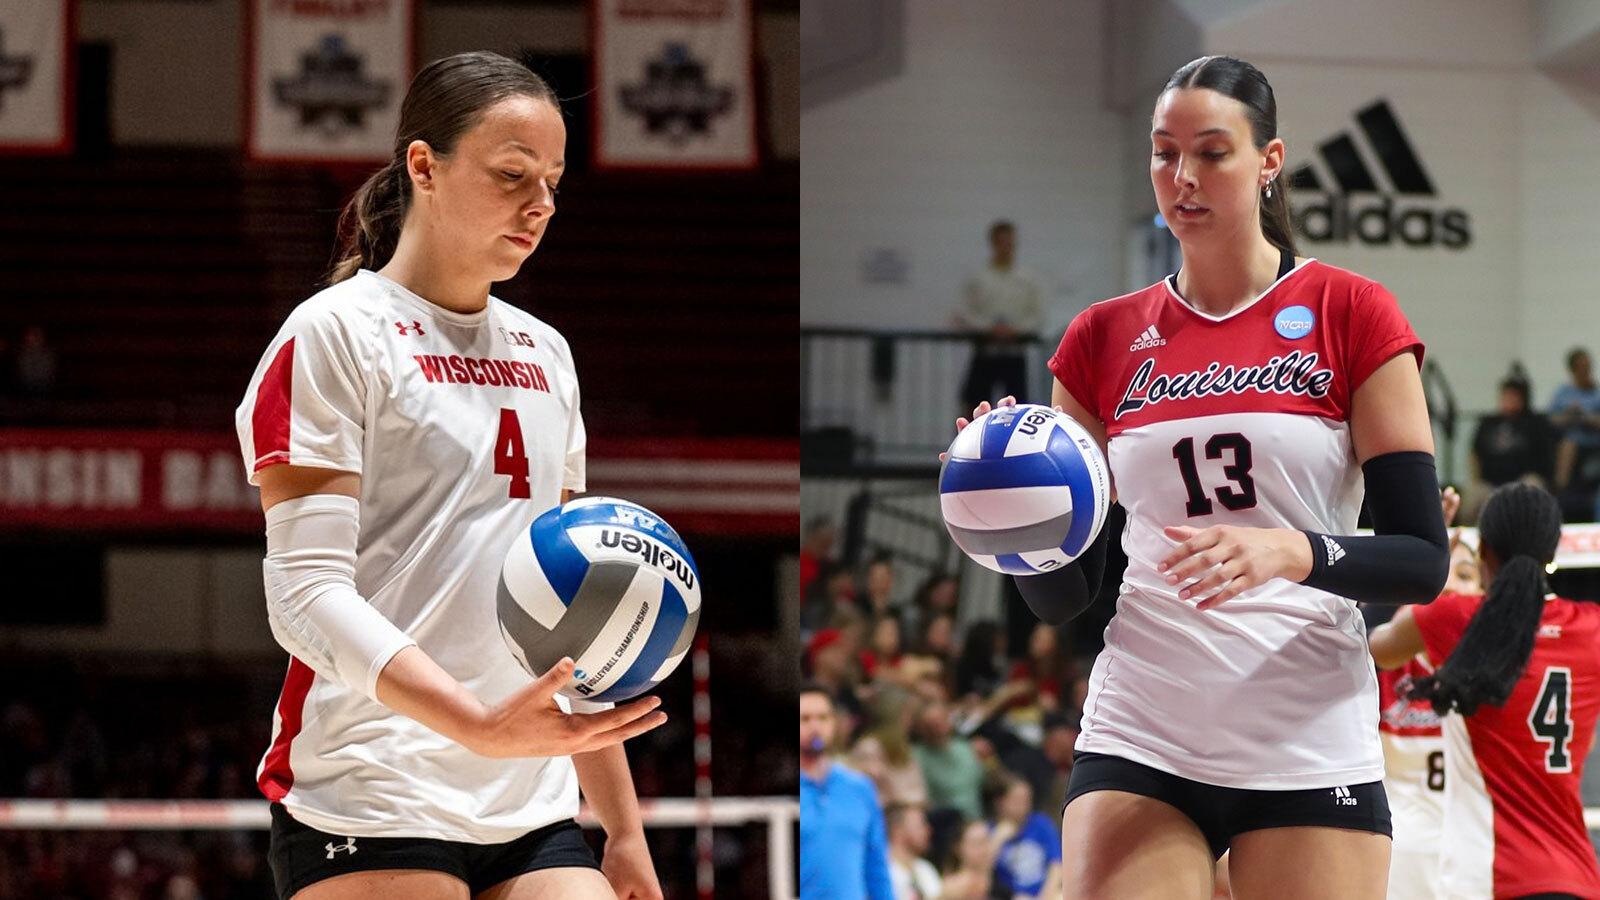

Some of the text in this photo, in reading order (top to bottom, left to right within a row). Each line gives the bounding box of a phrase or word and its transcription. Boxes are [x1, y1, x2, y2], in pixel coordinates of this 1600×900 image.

[1292, 191, 1470, 250] didas
[413, 355, 551, 393] WISCONSIN
[1130, 336, 1167, 351] adidas
[1114, 350, 1334, 421] Louisville
[0, 448, 143, 510] NSIN
[494, 408, 531, 499] 4
[1172, 432, 1258, 518] 13
[600, 529, 695, 591] molten
[586, 600, 650, 687] VOLLEYBALL CHAMPIONSHIP
[1527, 666, 1574, 774] 4
[1427, 750, 1445, 791] 8
